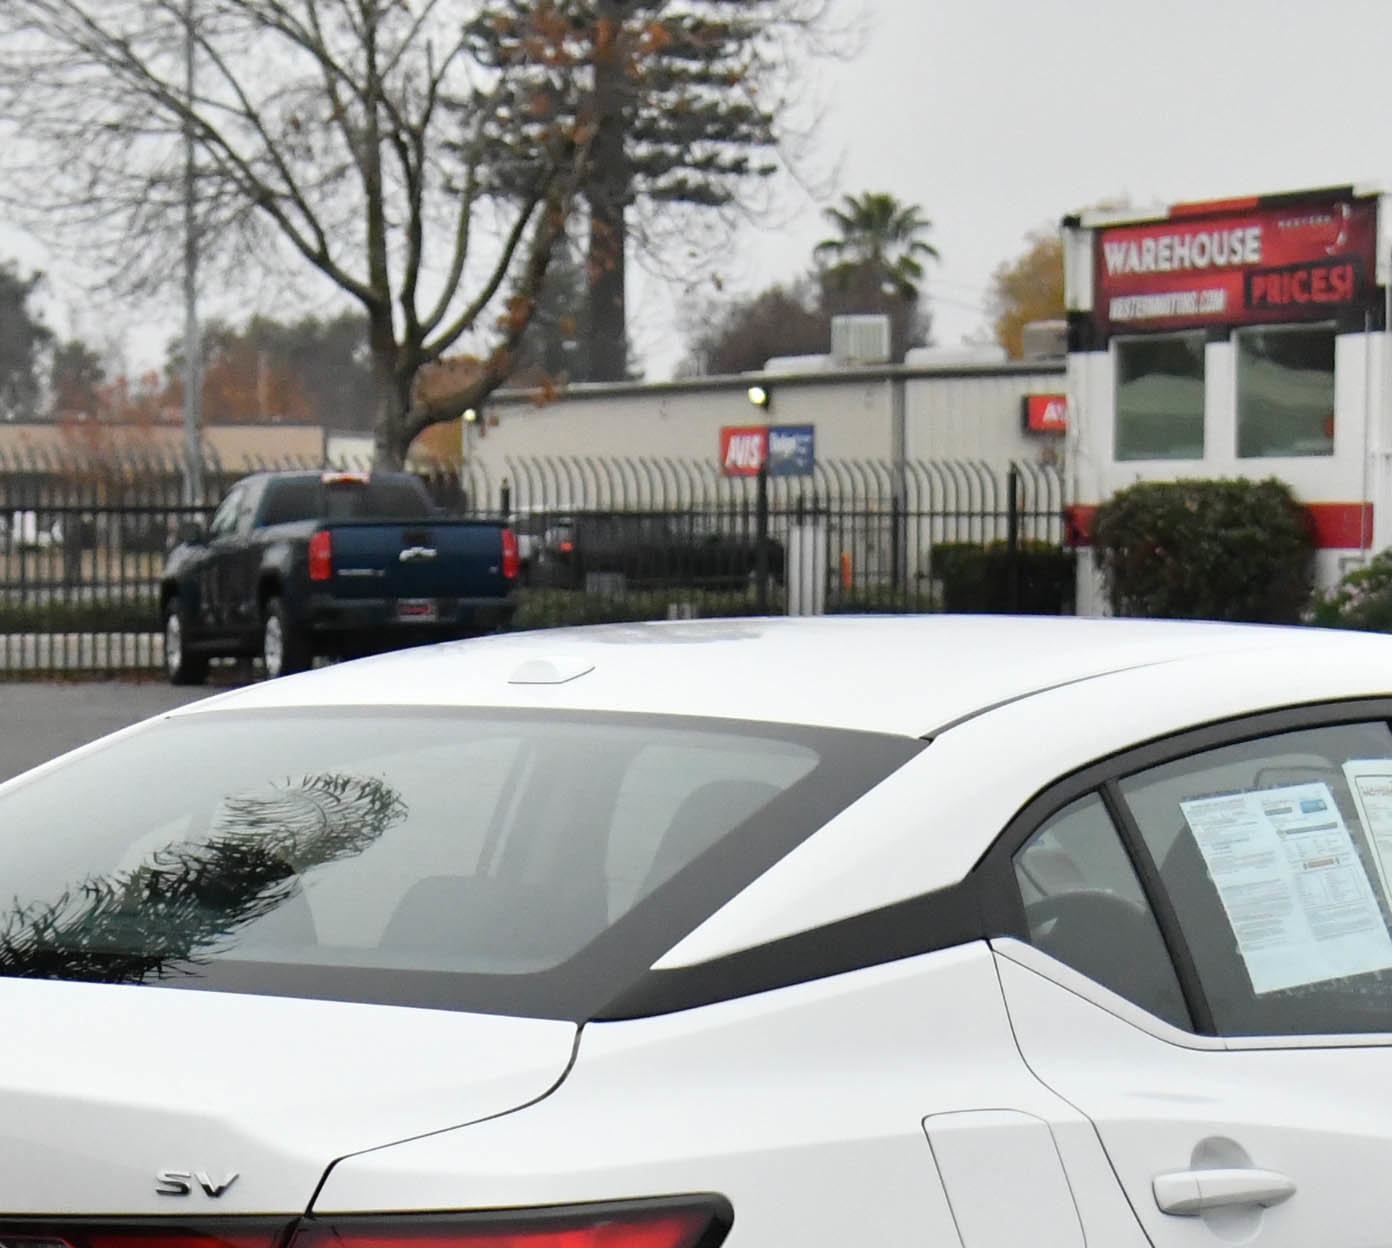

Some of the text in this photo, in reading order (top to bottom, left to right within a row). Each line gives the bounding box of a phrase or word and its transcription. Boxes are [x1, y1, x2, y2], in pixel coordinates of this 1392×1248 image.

[1104, 226, 1263, 276] WAREHOUSE
[725, 434, 762, 467] AVIS
[155, 1168, 240, 1198] SV
